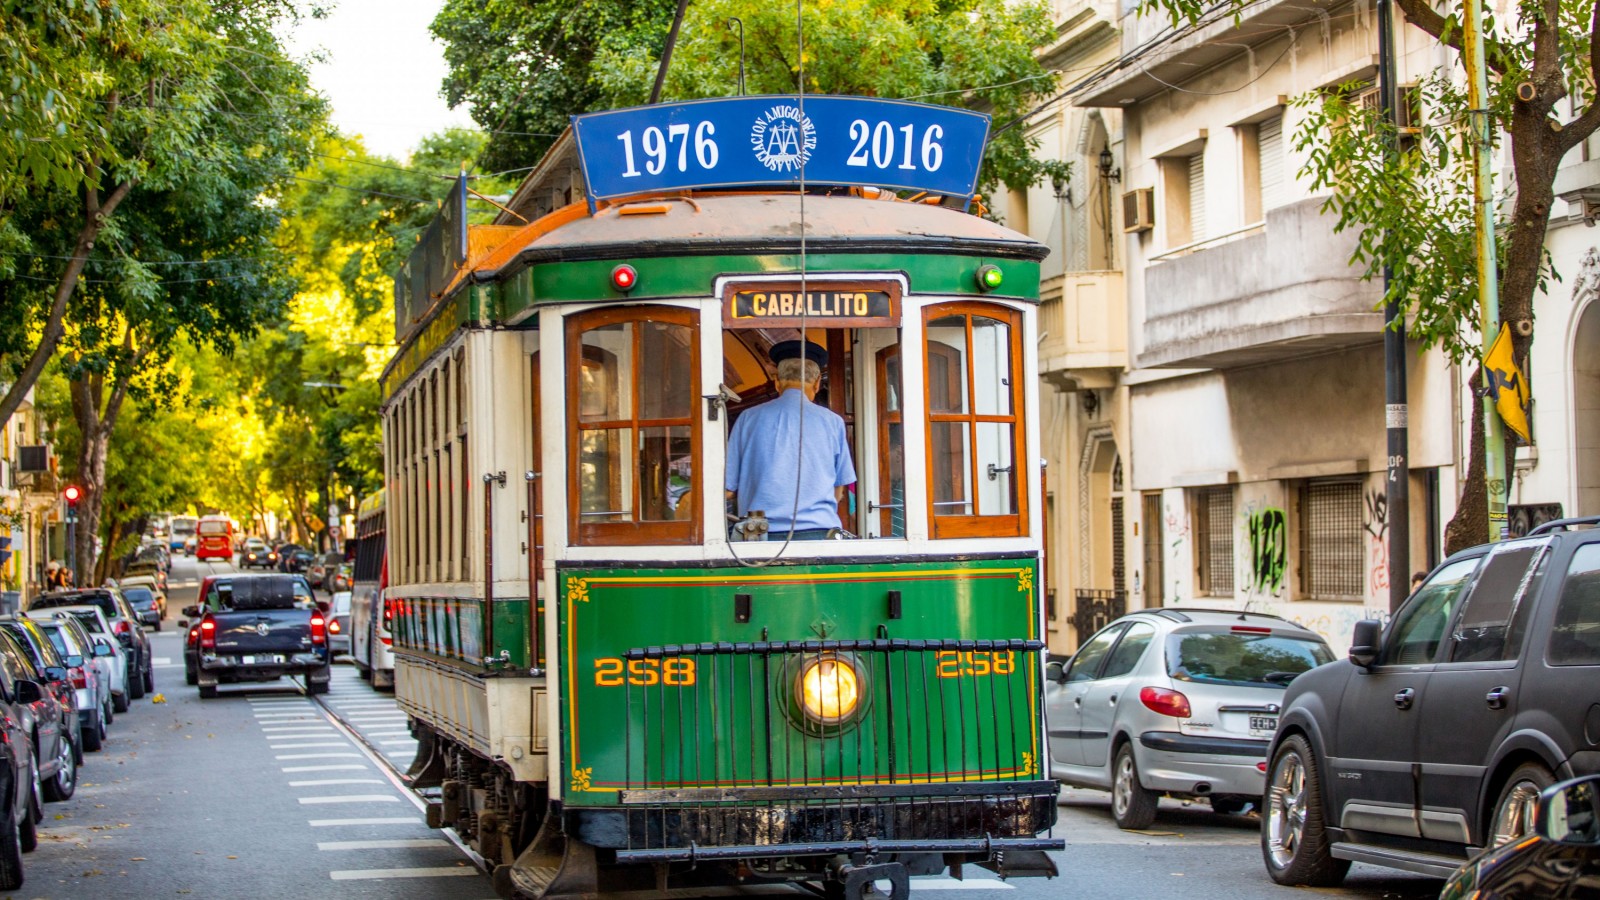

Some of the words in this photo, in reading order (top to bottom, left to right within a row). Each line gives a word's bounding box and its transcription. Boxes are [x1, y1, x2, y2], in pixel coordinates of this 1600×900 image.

[764, 105, 806, 123] AMIGOS
[801, 116, 817, 137] DEL
[617, 120, 719, 178] 1976
[846, 118, 944, 172] 2016
[753, 293, 868, 316] CABALLITO
[594, 657, 697, 687] 258
[935, 649, 1015, 678] 258
